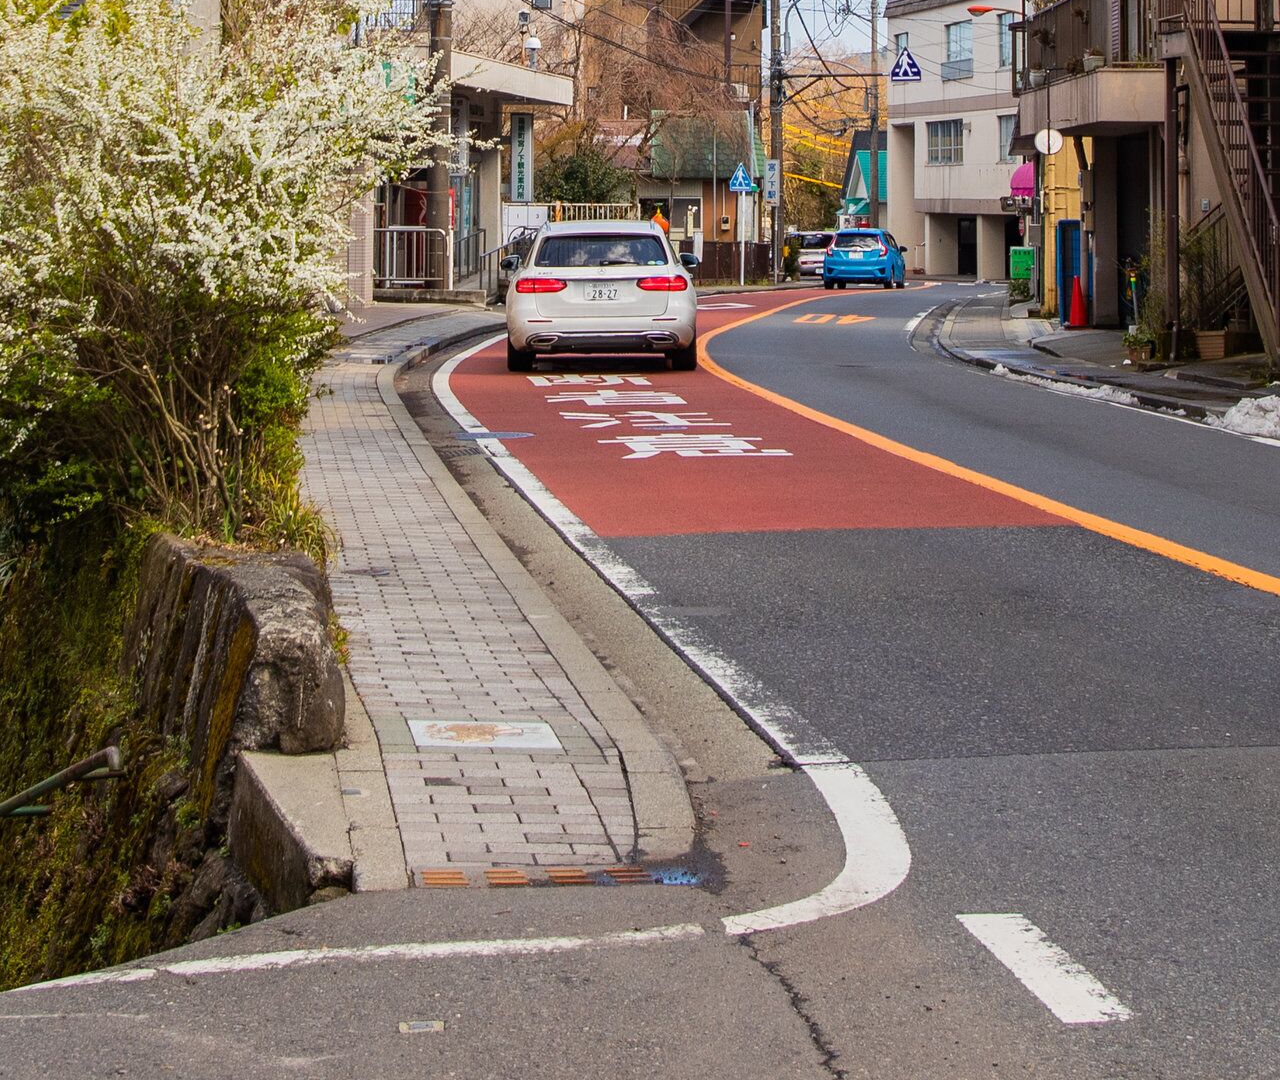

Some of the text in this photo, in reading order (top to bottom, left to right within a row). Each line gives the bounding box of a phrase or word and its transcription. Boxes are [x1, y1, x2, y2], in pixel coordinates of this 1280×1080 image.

[767, 162, 777, 199] 宮ノ下駅
[592, 288, 618, 299] 28-27
